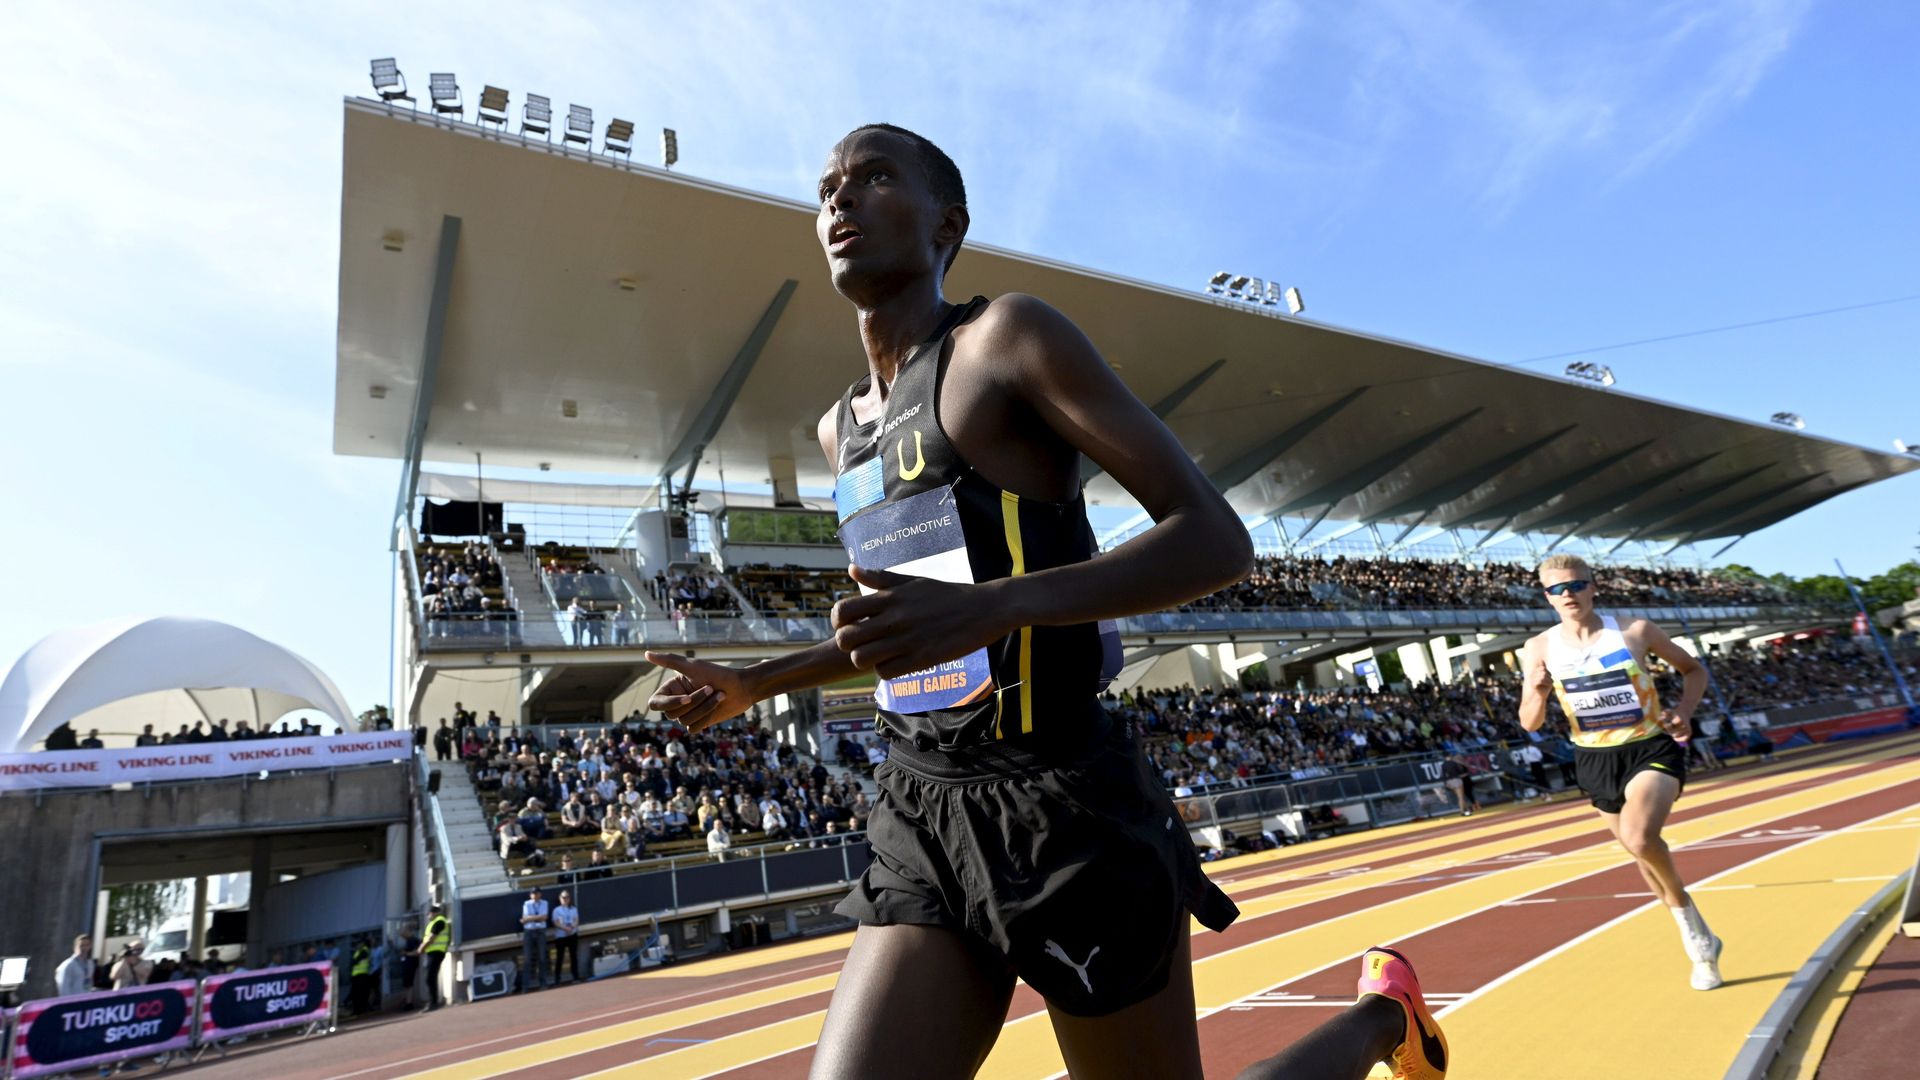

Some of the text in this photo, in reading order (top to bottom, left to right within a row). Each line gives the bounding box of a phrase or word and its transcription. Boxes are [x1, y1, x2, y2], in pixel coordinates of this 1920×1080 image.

[885, 402, 922, 434] netvisor
[860, 515, 952, 553] HEDIN AUTOMOTIVE
[923, 671, 967, 693] GAMES
[229, 746, 314, 762] VIKING LINE
[328, 738, 405, 754] VIKING LINE
[61, 761, 100, 773] LINE
[117, 754, 214, 770] VIKING LINE
[234, 980, 288, 1002] TURKU
[266, 994, 308, 1014] SPORT
[62, 1004, 135, 1032] TURKU
[104, 1019, 163, 1044] SPORT
